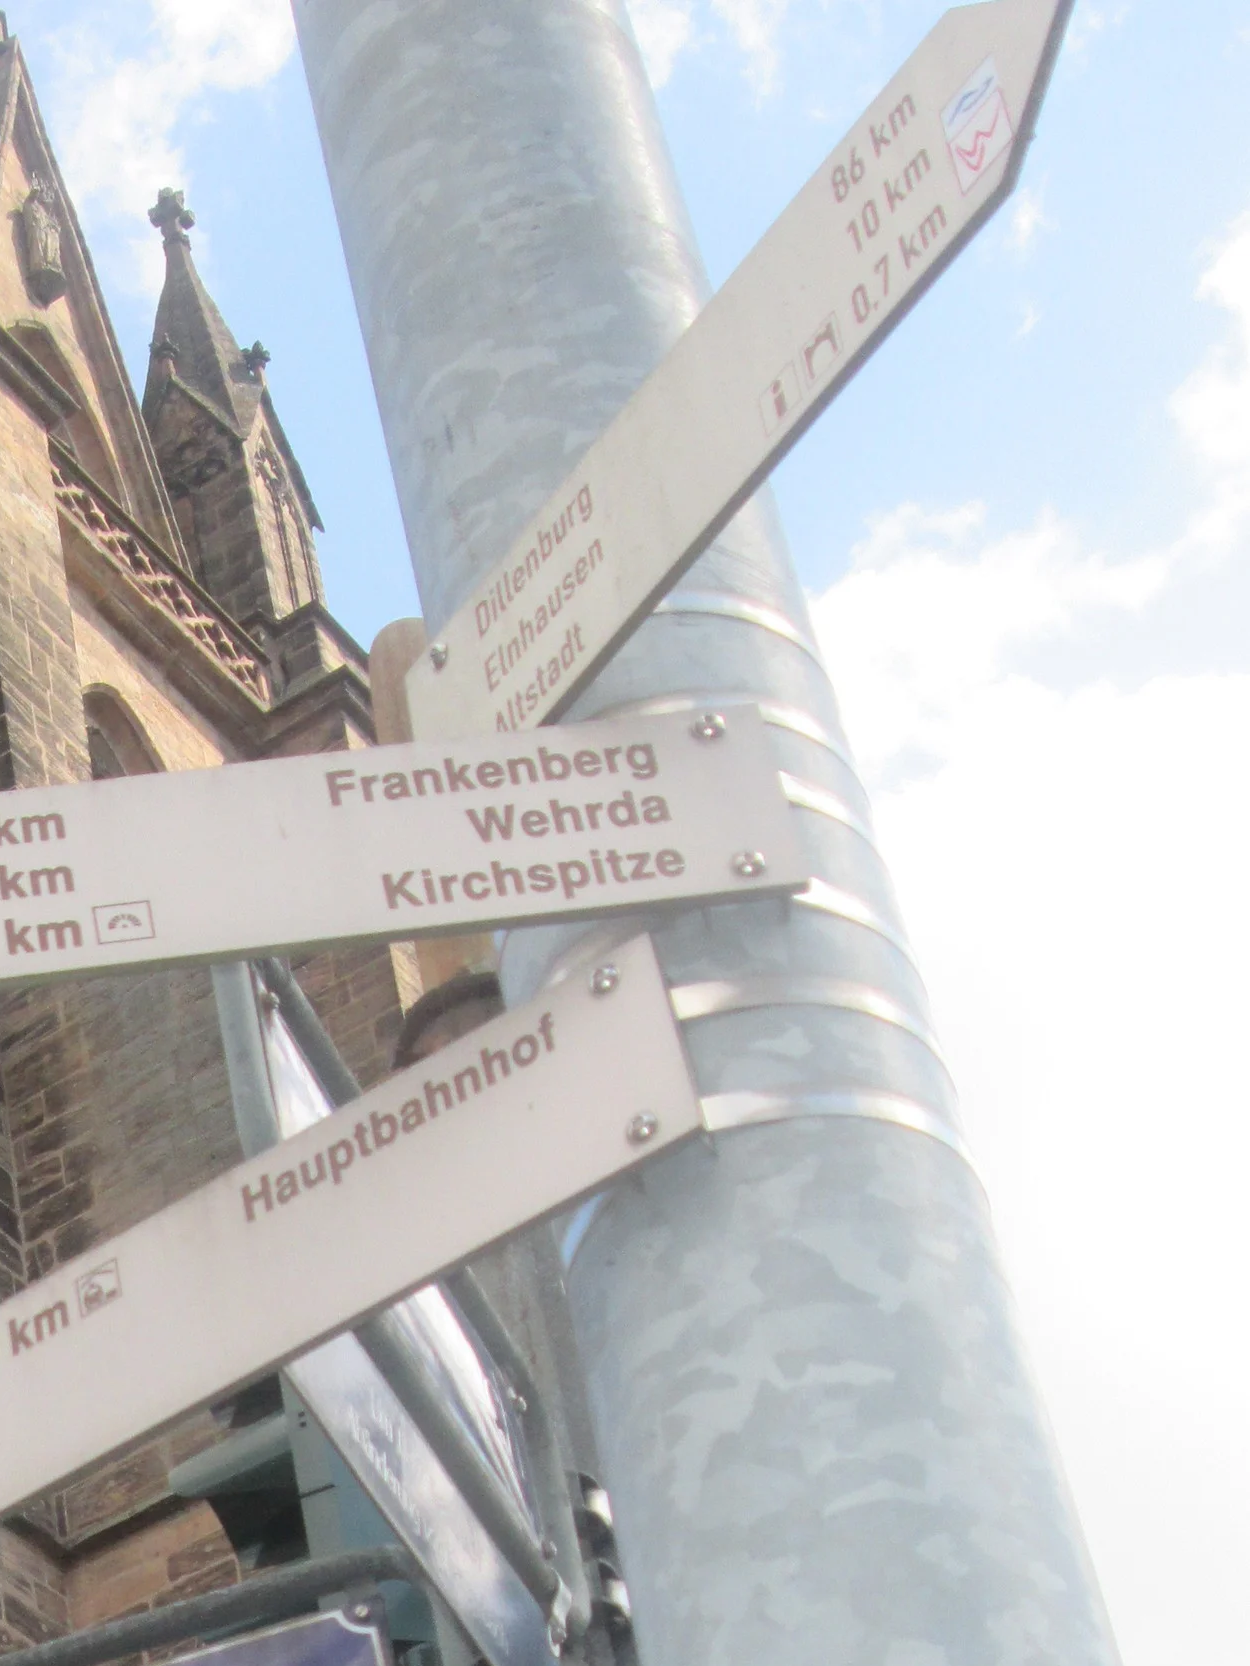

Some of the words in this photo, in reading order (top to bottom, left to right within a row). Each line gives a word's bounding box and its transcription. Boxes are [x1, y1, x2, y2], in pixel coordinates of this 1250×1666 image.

[831, 147, 865, 203] 86
[870, 94, 916, 158] km
[846, 199, 880, 252] 10
[883, 148, 931, 214] km
[898, 204, 947, 269] km
[475, 483, 593, 638] Dillenburg
[484, 538, 604, 692] Elnhausen
[496, 622, 585, 732] Altstadt
[325, 742, 658, 806] Frankenberg
[466, 792, 671, 843] Wehrda
[383, 847, 686, 909] Kirchspitze
[5, 917, 83, 955] km
[241, 1012, 555, 1222] Hauptbahnhof
[8, 1300, 70, 1356] km
